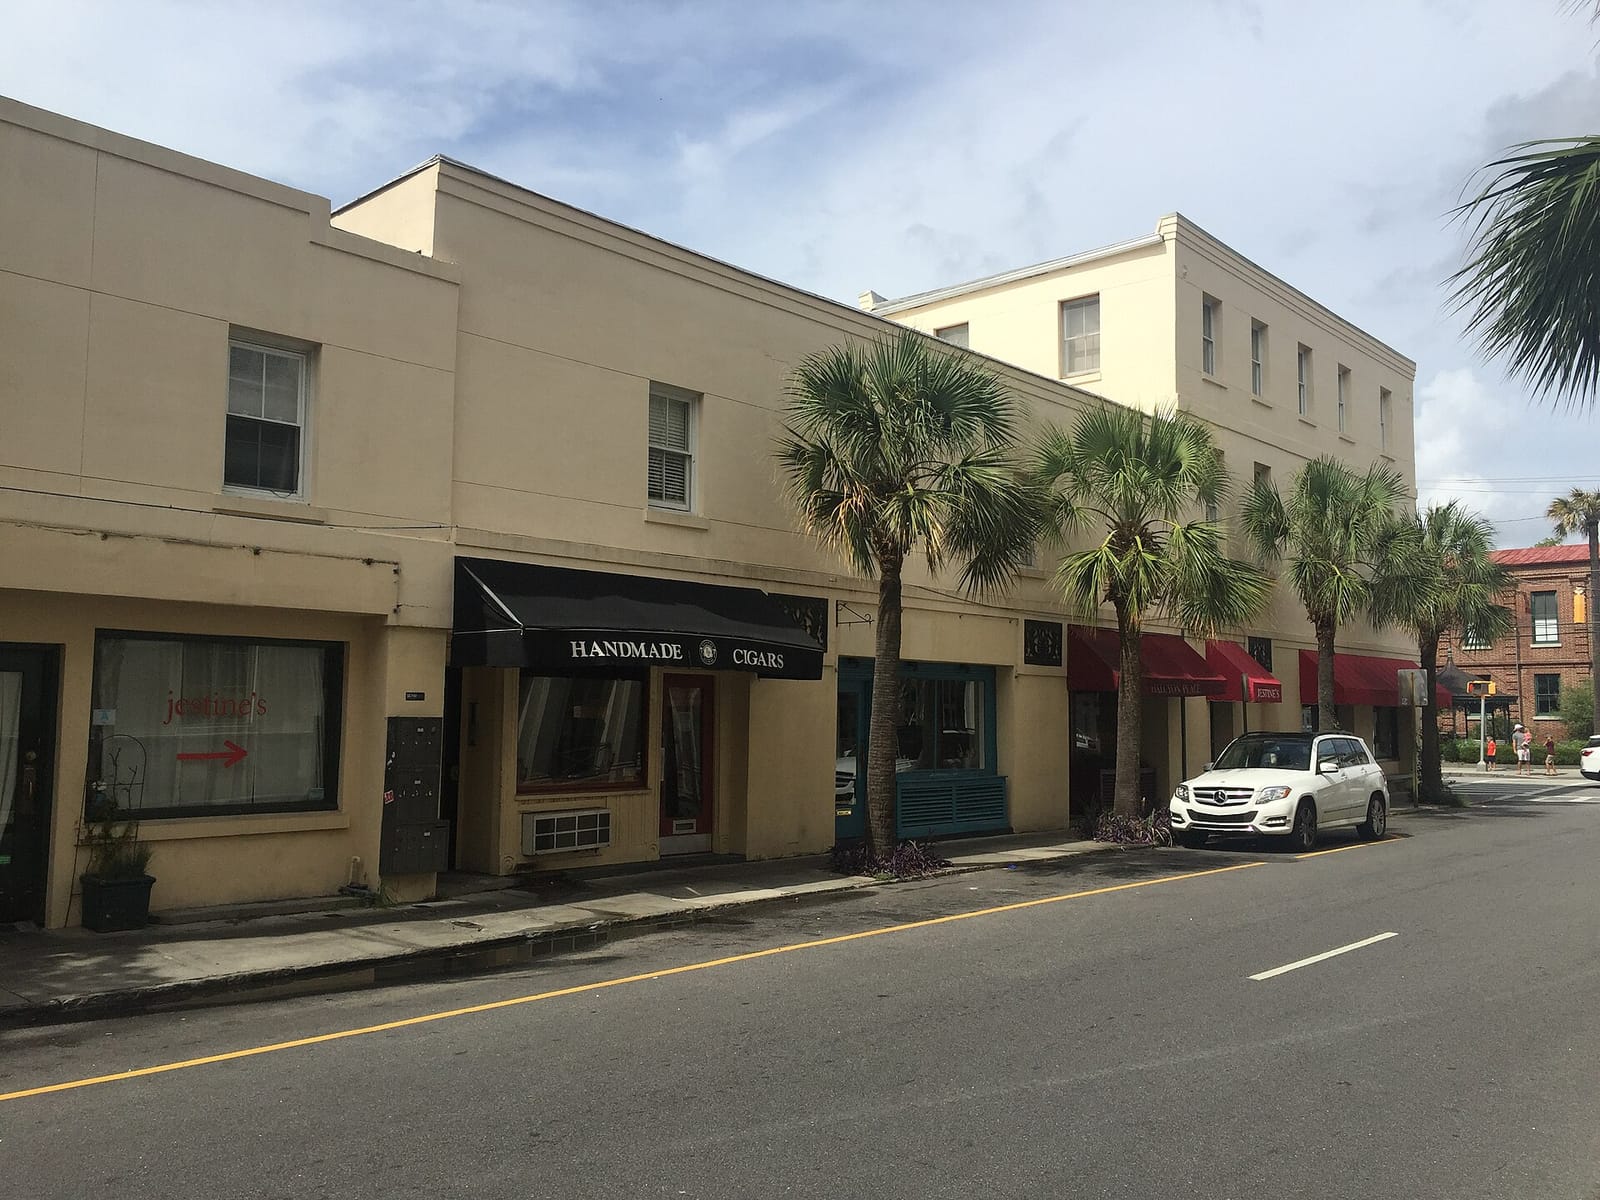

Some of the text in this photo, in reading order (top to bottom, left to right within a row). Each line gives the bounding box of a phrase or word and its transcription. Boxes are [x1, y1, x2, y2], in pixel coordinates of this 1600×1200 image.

[570, 640, 683, 660] HANDMADE
[733, 648, 784, 669] CIGARS
[163, 690, 268, 725] jestine's
